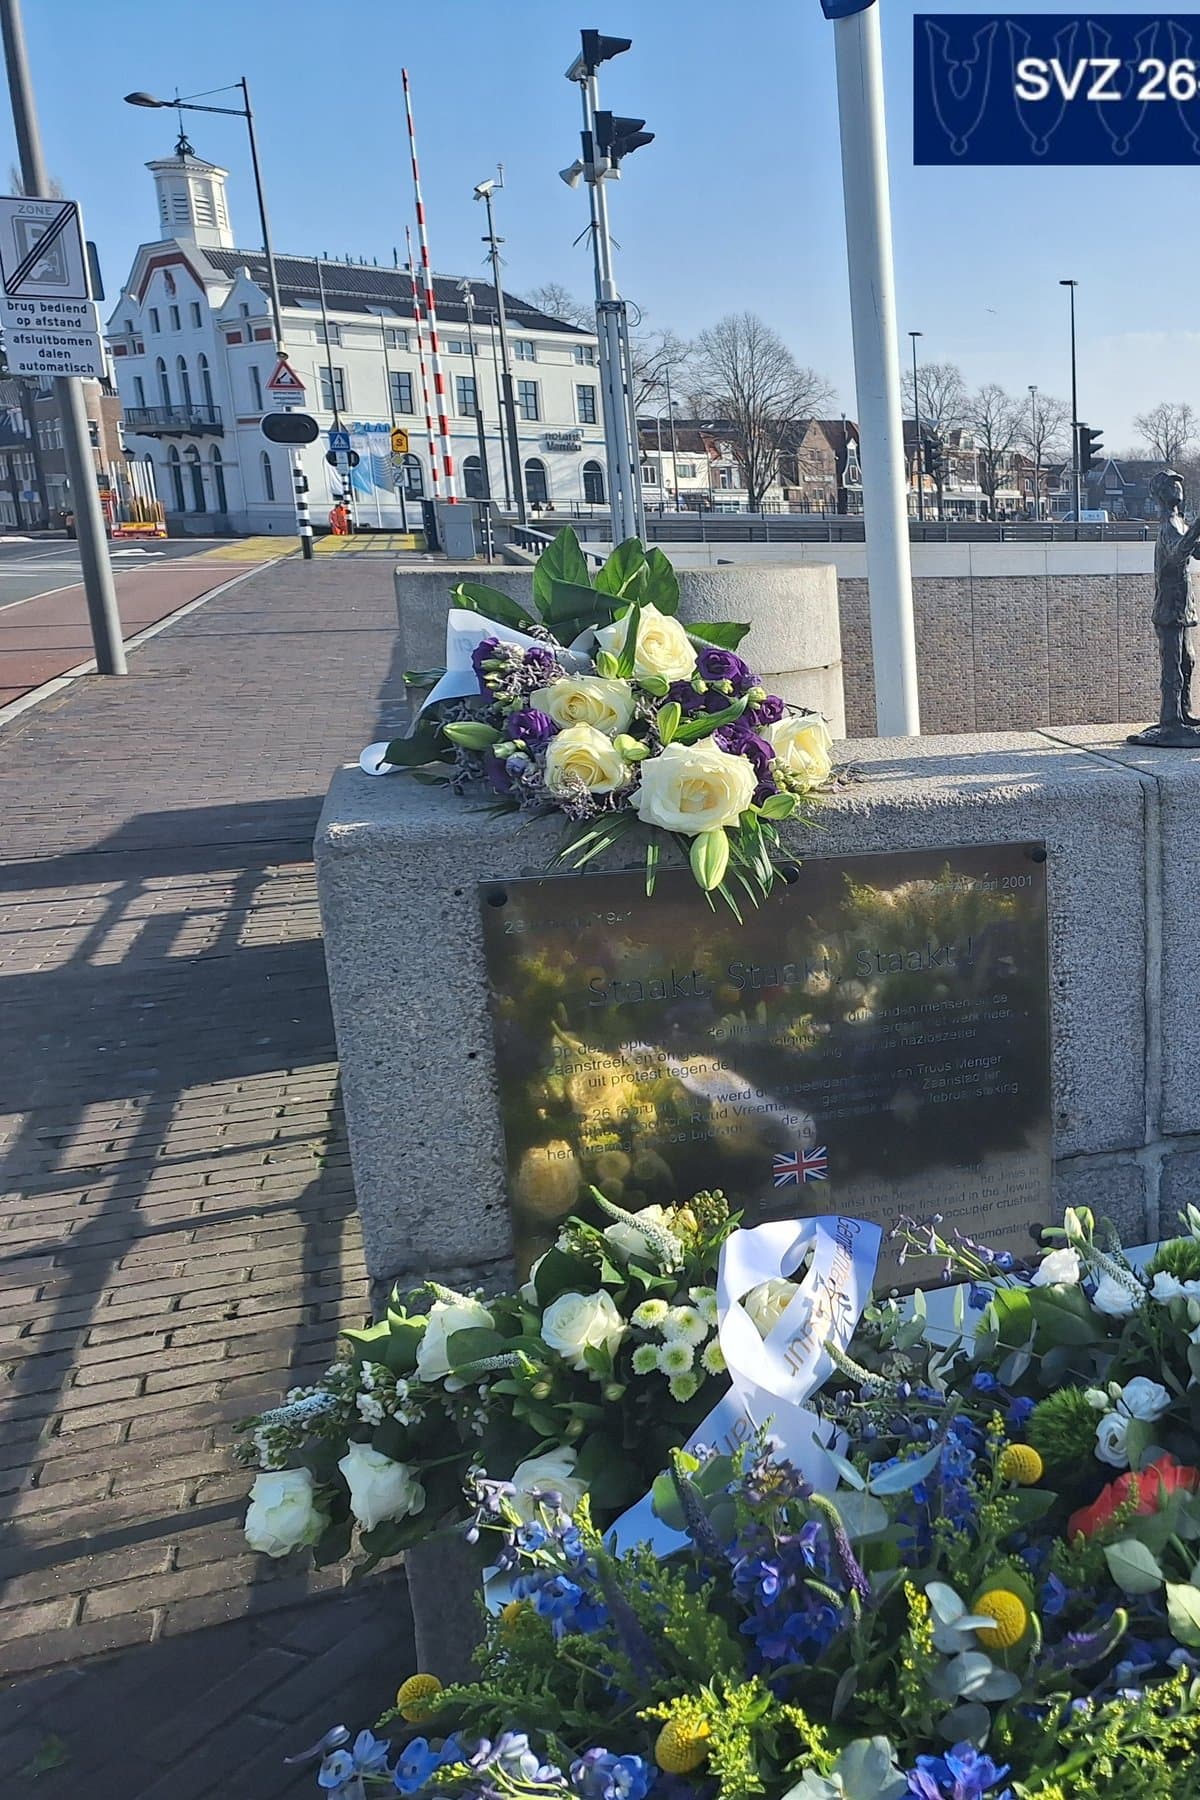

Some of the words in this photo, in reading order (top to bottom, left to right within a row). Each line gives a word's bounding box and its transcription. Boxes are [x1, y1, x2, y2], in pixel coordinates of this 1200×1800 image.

[18, 204, 53, 216] ZONE
[7, 301, 35, 314] brug
[40, 301, 87, 314] bediend
[17, 316, 32, 329] op
[35, 316, 81, 329] afstand
[13, 333, 93, 346] afsluitbomen
[38, 348, 71, 360] dalen
[19, 361, 94, 374] automatisch
[1002, 875, 1032, 890] 2001
[855, 941, 957, 977] Staakt
[920, 999, 970, 1014] mensen
[588, 1074, 607, 1088] uit
[611, 1068, 664, 1087] protest
[667, 1062, 708, 1080] tegen
[711, 1059, 730, 1072] de
[592, 1106, 612, 1121] 26
[717, 1088, 752, 1103] werd
[916, 1061, 952, 1076] Truus
[732, 1102, 795, 1119] Vreema
[782, 1112, 799, 1126] de
[969, 1190, 979, 1201] in
